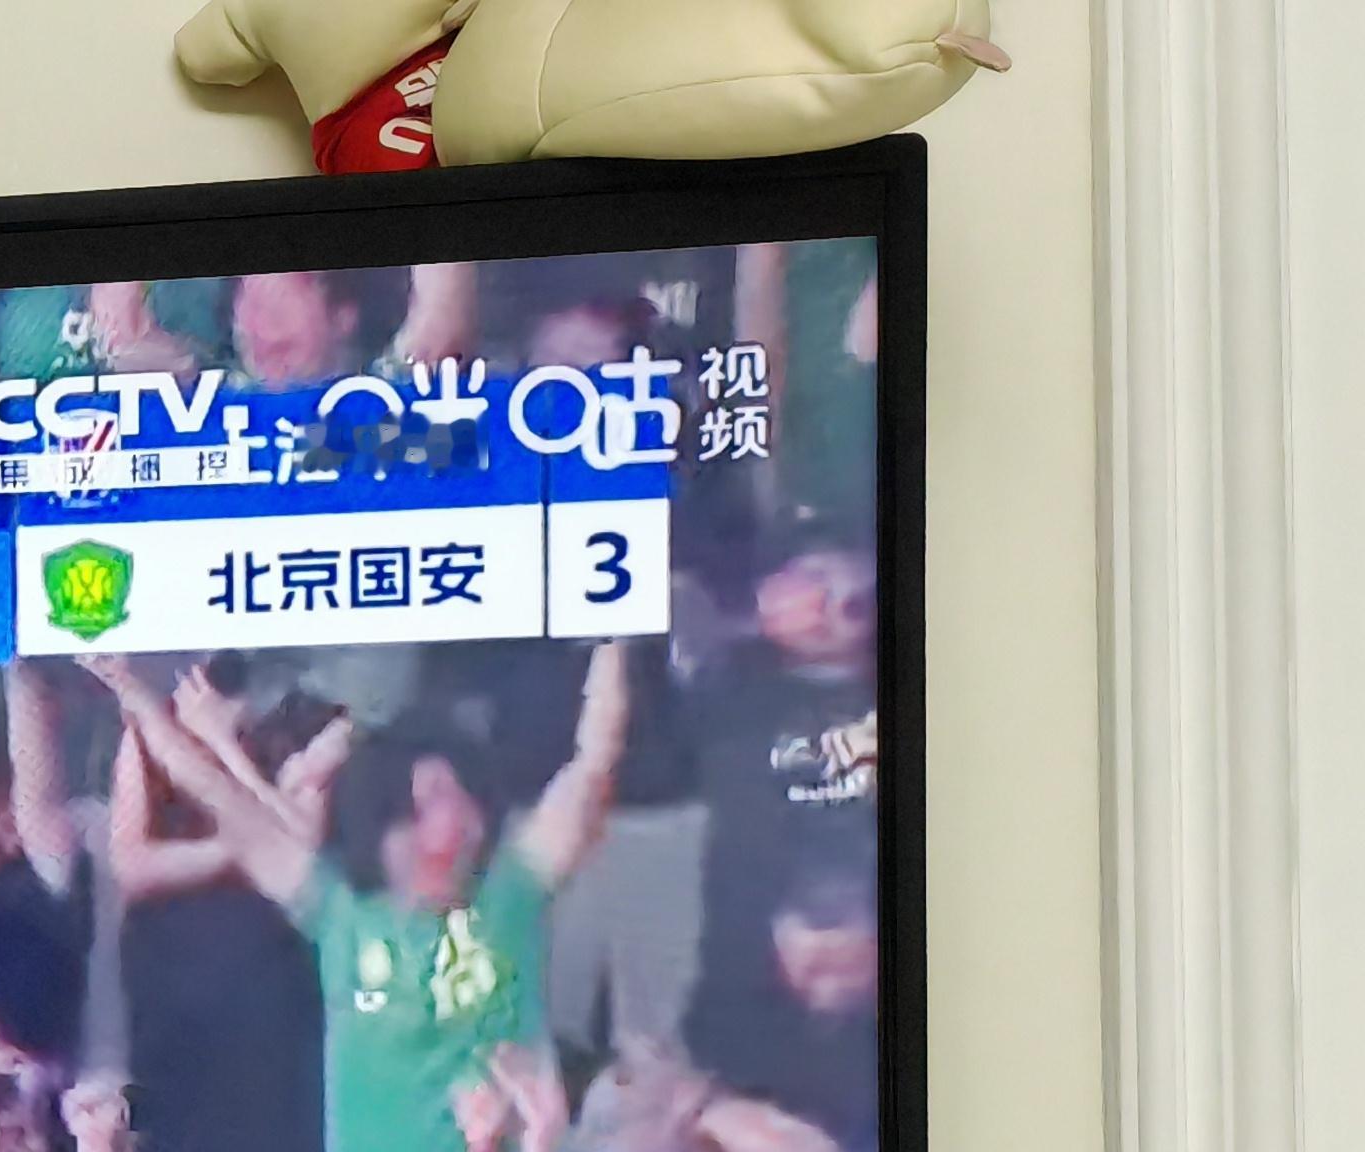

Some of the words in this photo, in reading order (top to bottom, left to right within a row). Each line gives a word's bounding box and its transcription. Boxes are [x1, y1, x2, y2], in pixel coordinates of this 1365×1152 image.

[208, 542, 486, 614] 北京国安
[584, 530, 632, 604] 3
